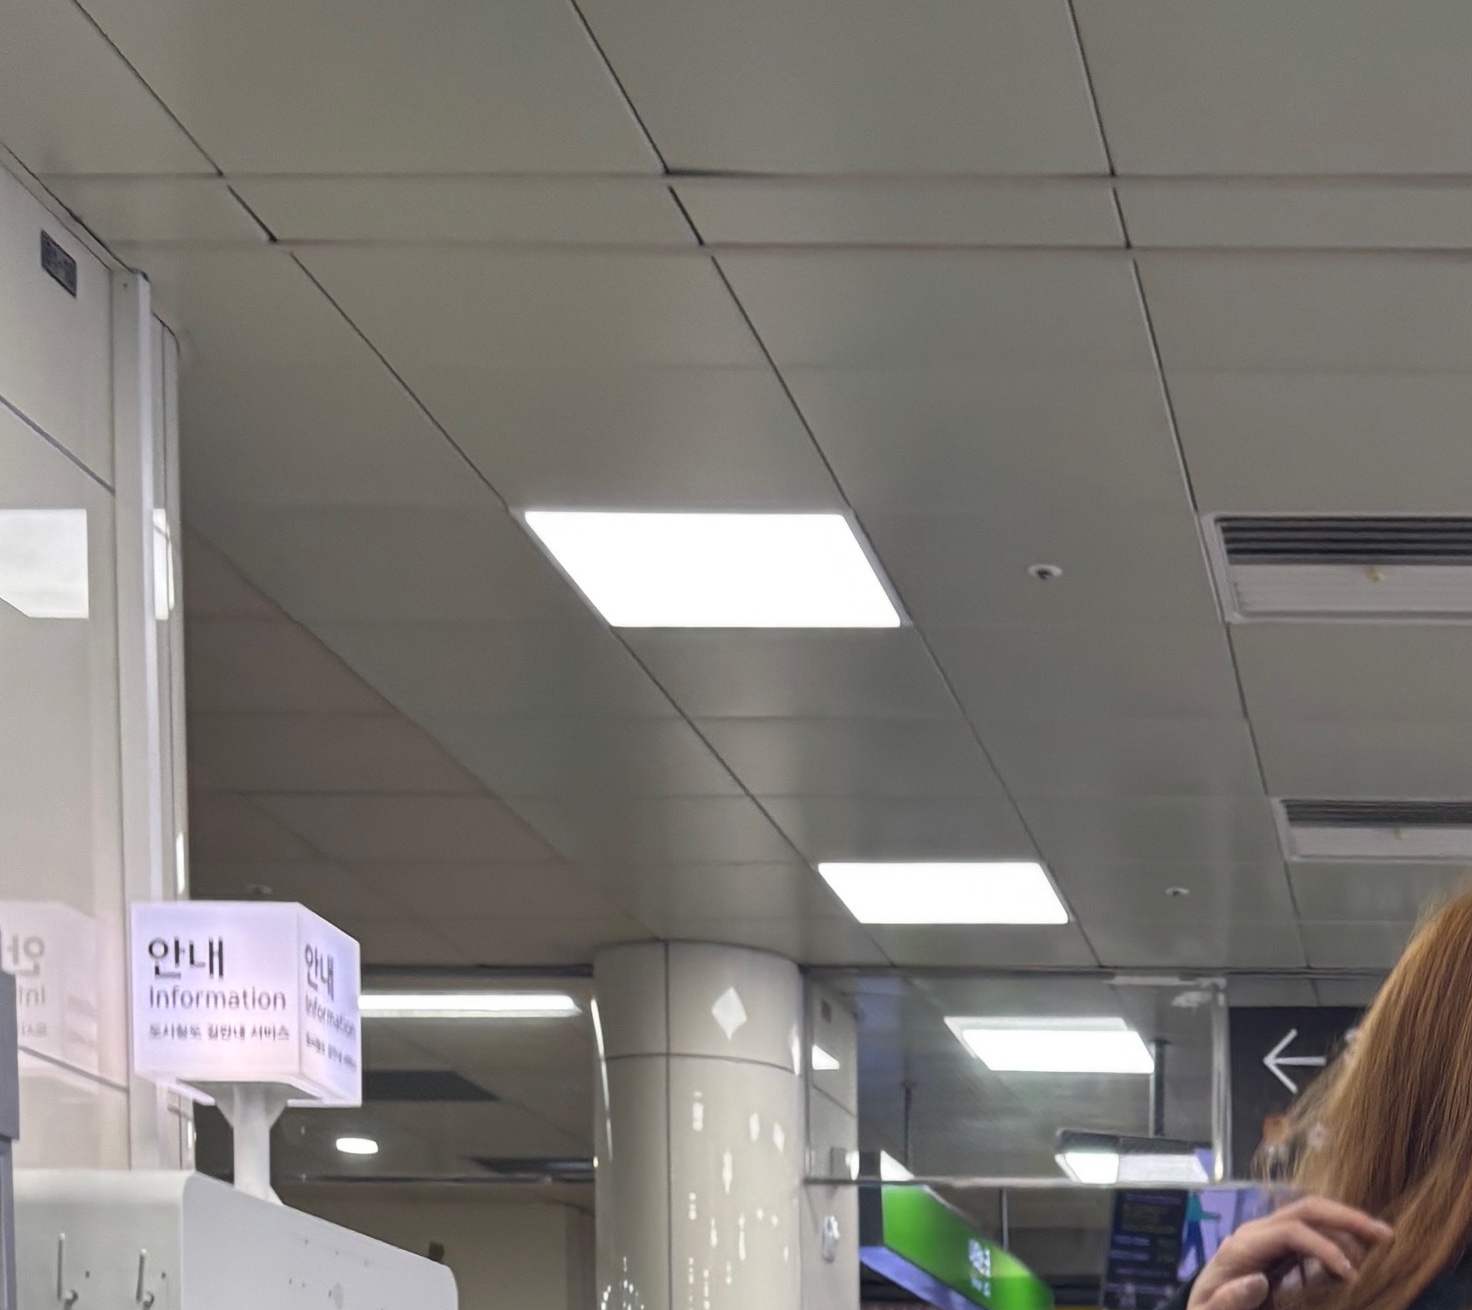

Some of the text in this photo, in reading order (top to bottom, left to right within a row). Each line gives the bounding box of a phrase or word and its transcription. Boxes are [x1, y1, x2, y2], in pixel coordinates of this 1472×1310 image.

[147, 935, 225, 980] 안내
[304, 942, 335, 1002] 안내
[149, 984, 287, 1010] Information
[304, 992, 357, 1040] Information
[250, 1023, 290, 1041] 서비스
